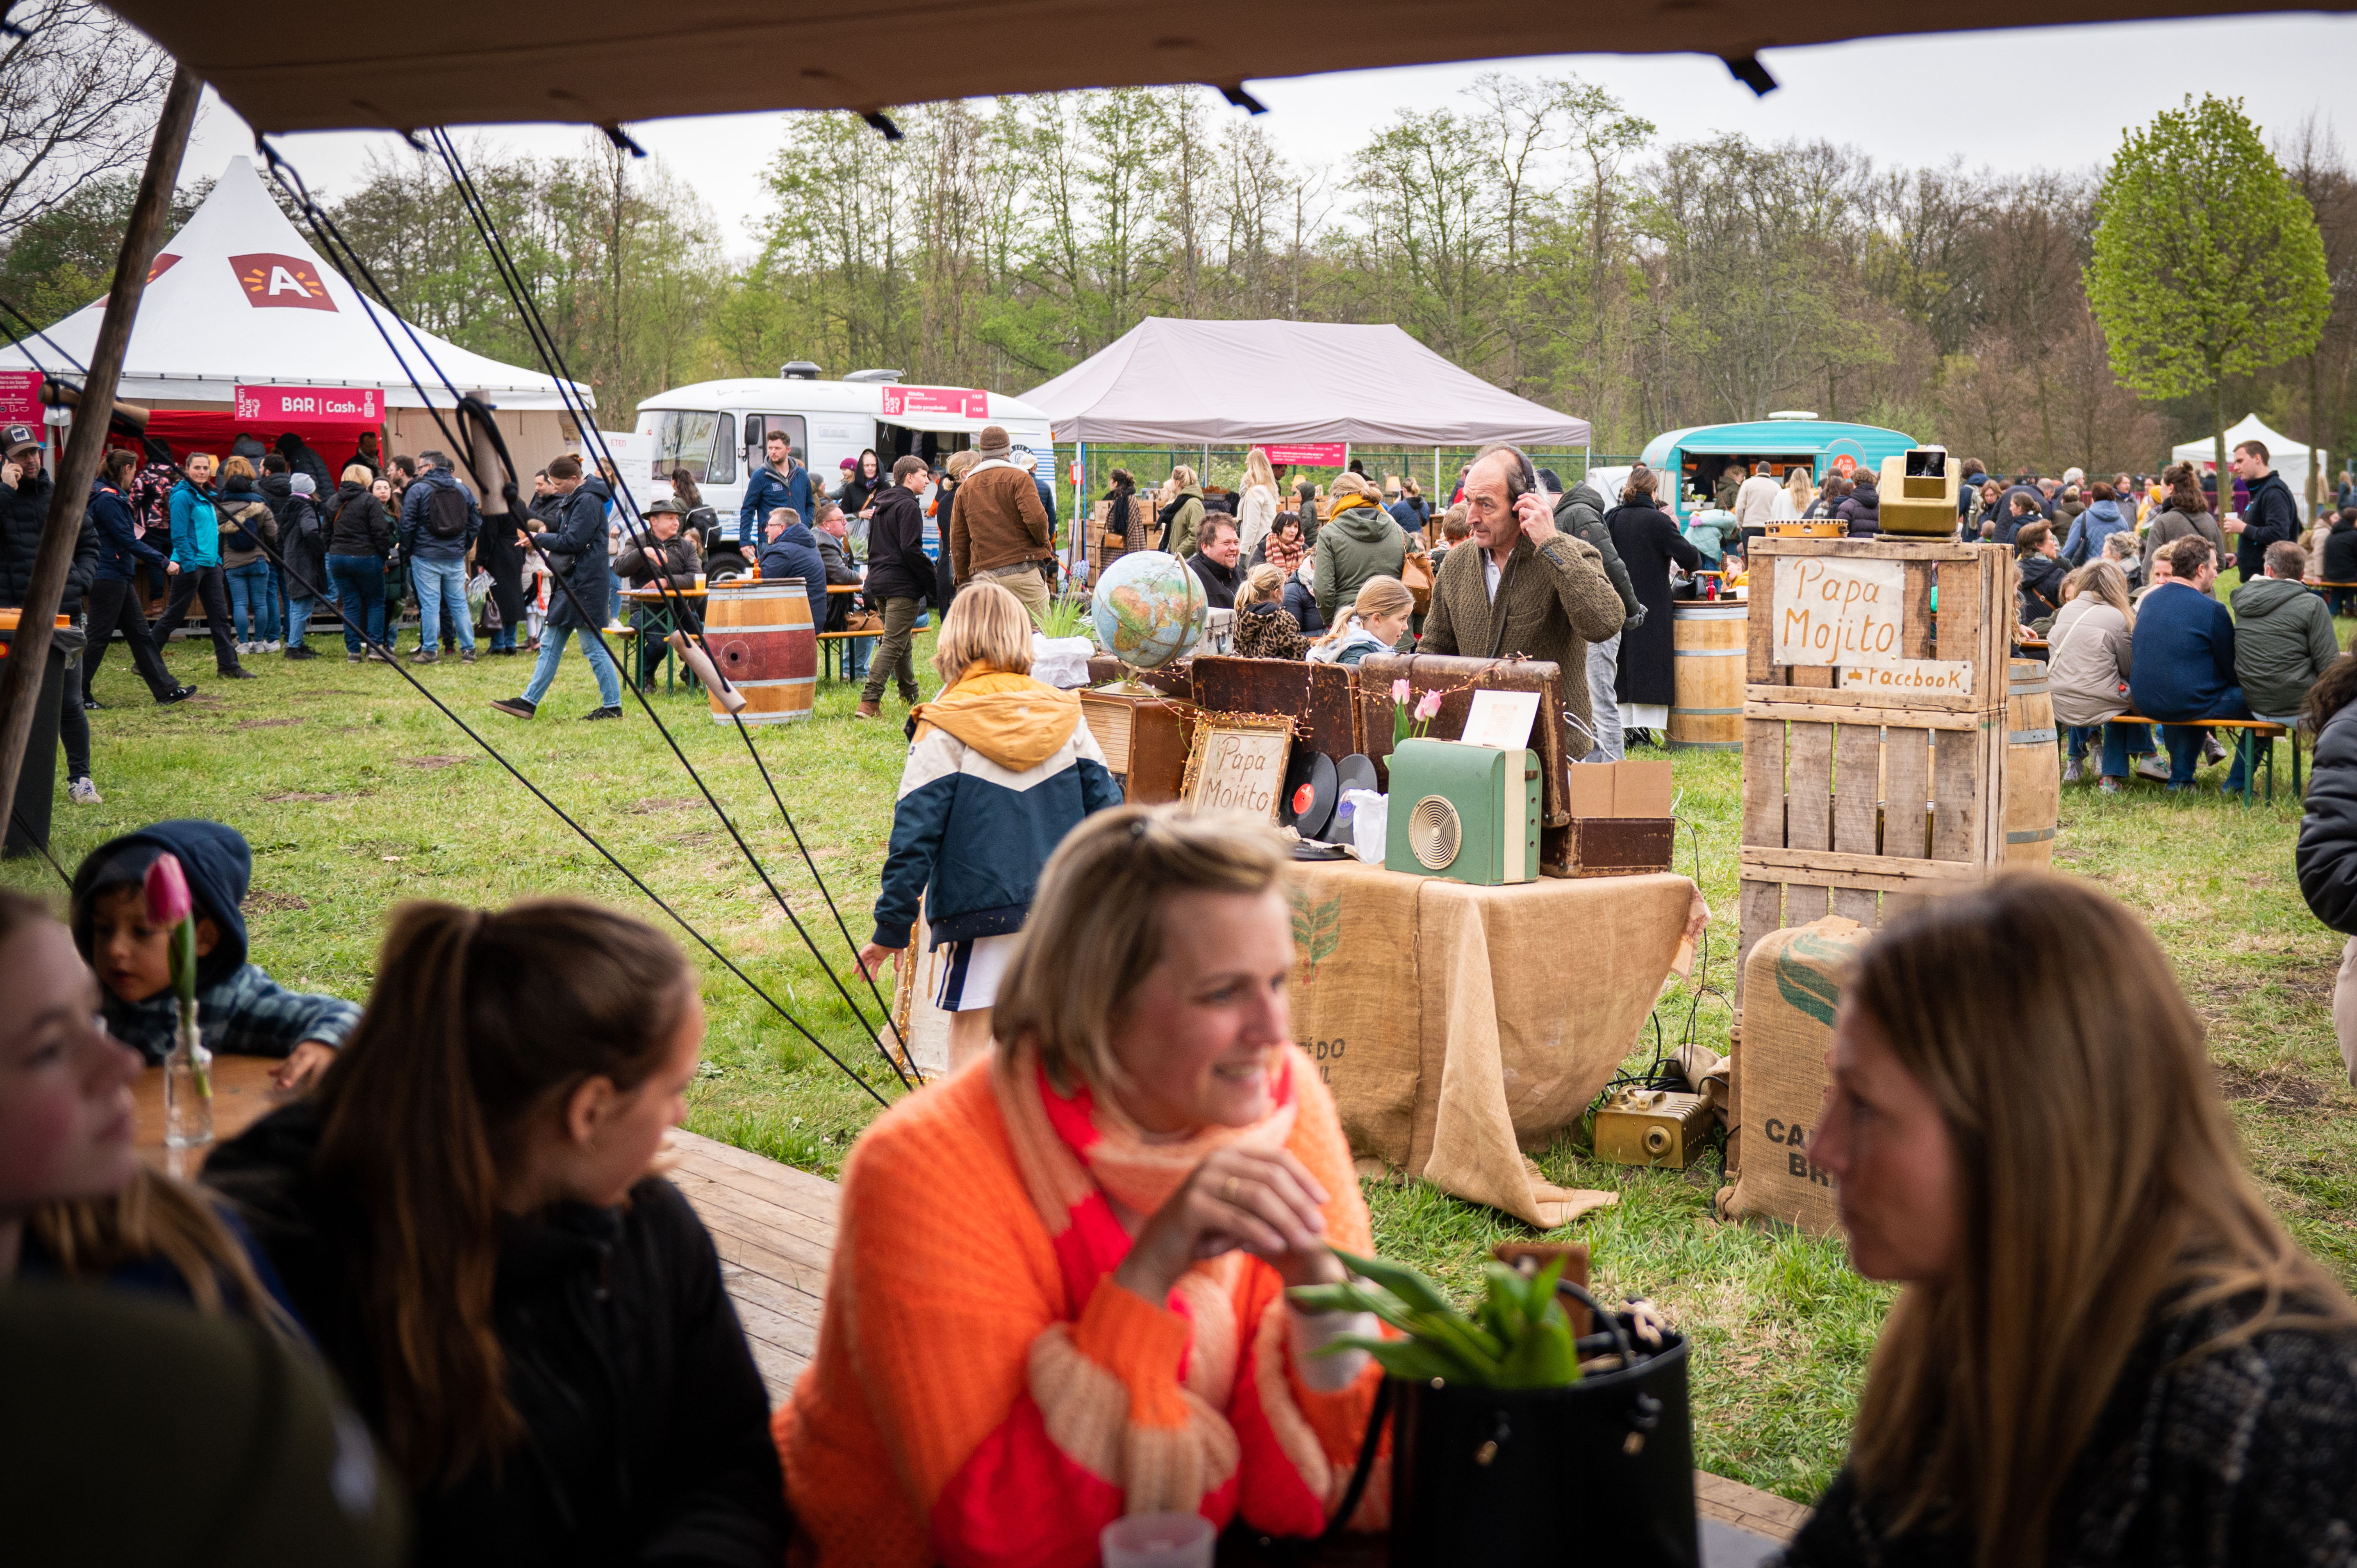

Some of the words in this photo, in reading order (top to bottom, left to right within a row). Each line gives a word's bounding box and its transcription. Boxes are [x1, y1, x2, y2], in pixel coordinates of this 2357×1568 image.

[268, 266, 312, 298] A
[282, 397, 314, 412] BAR
[326, 401, 355, 413] Cash
[611, 439, 626, 447] ETEN
[1794, 557, 1879, 615] Papa
[1784, 608, 1895, 664] Mojito
[1219, 736, 1265, 782] Papa
[1317, 1038, 1345, 1060] DO
